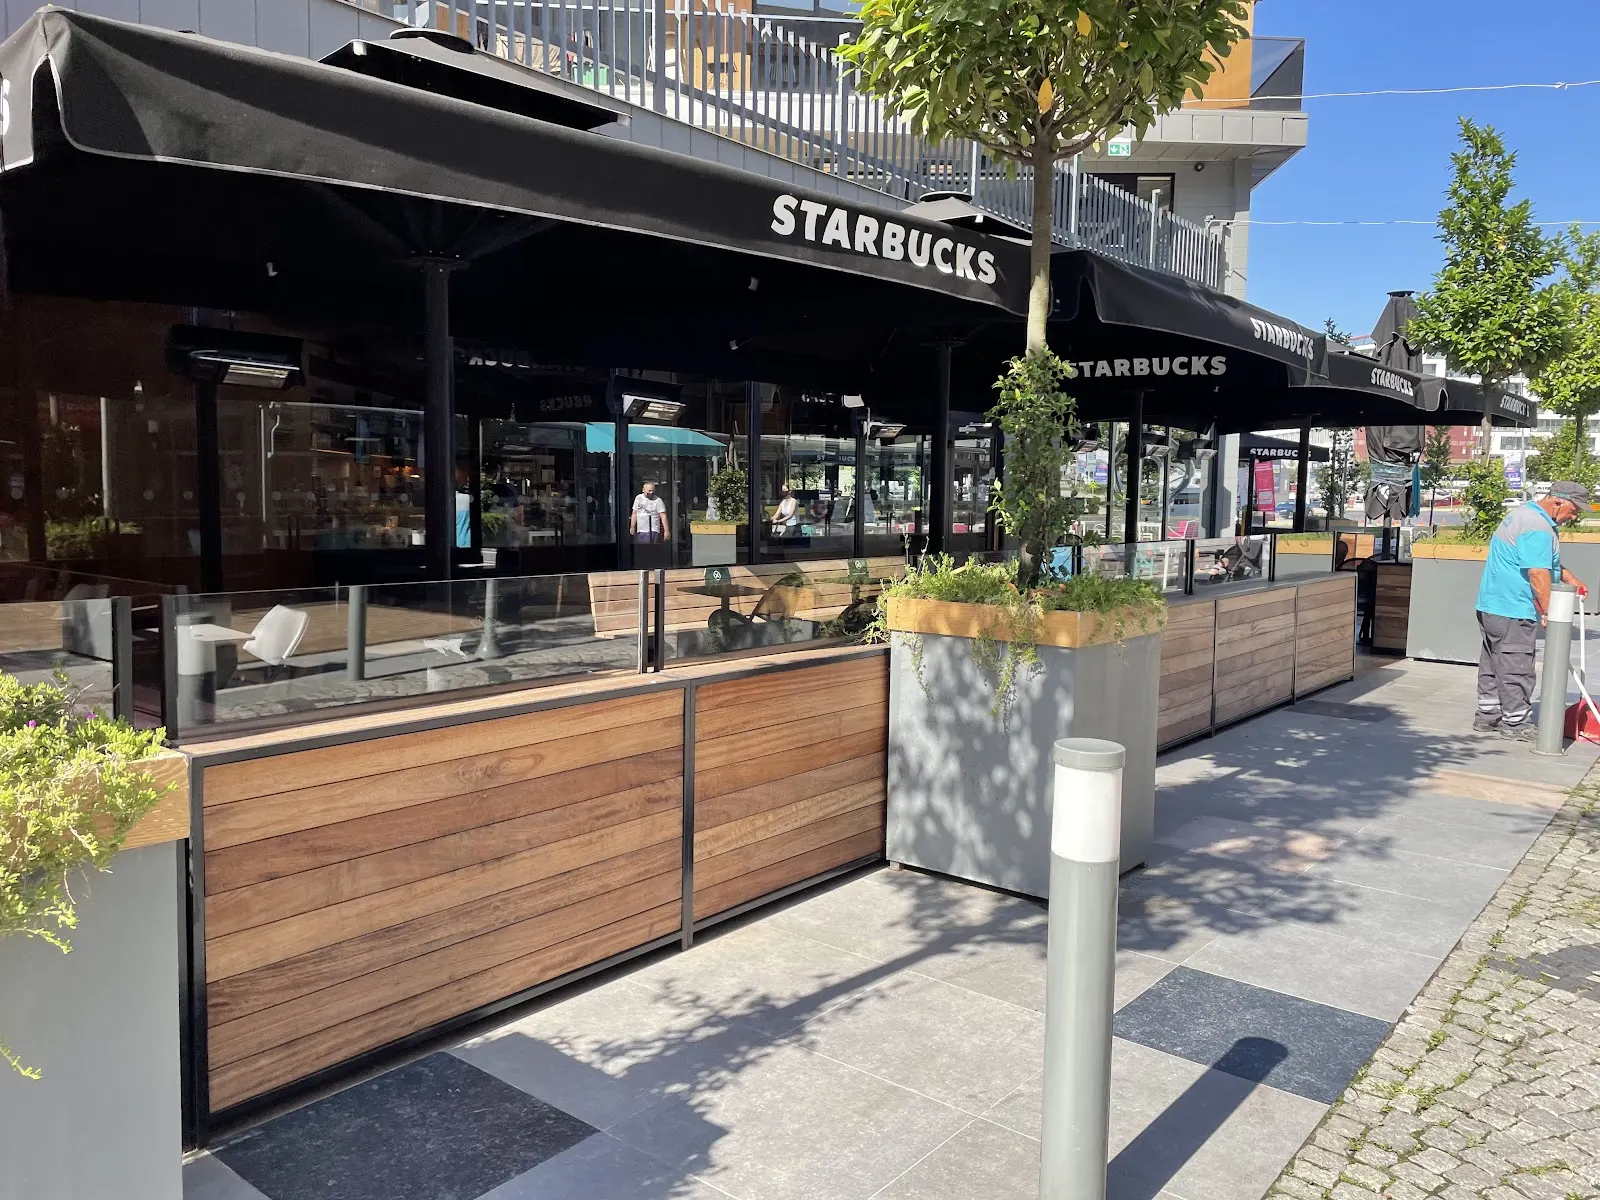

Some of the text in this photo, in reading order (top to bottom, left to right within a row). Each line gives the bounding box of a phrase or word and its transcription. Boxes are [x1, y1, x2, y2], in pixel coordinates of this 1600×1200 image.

[771, 194, 997, 285] STARBUCKS
[1249, 316, 1314, 360] STARBUCKS
[1370, 367, 1414, 397] STARBUCKS
[1249, 447, 1312, 457] STARBUCS
